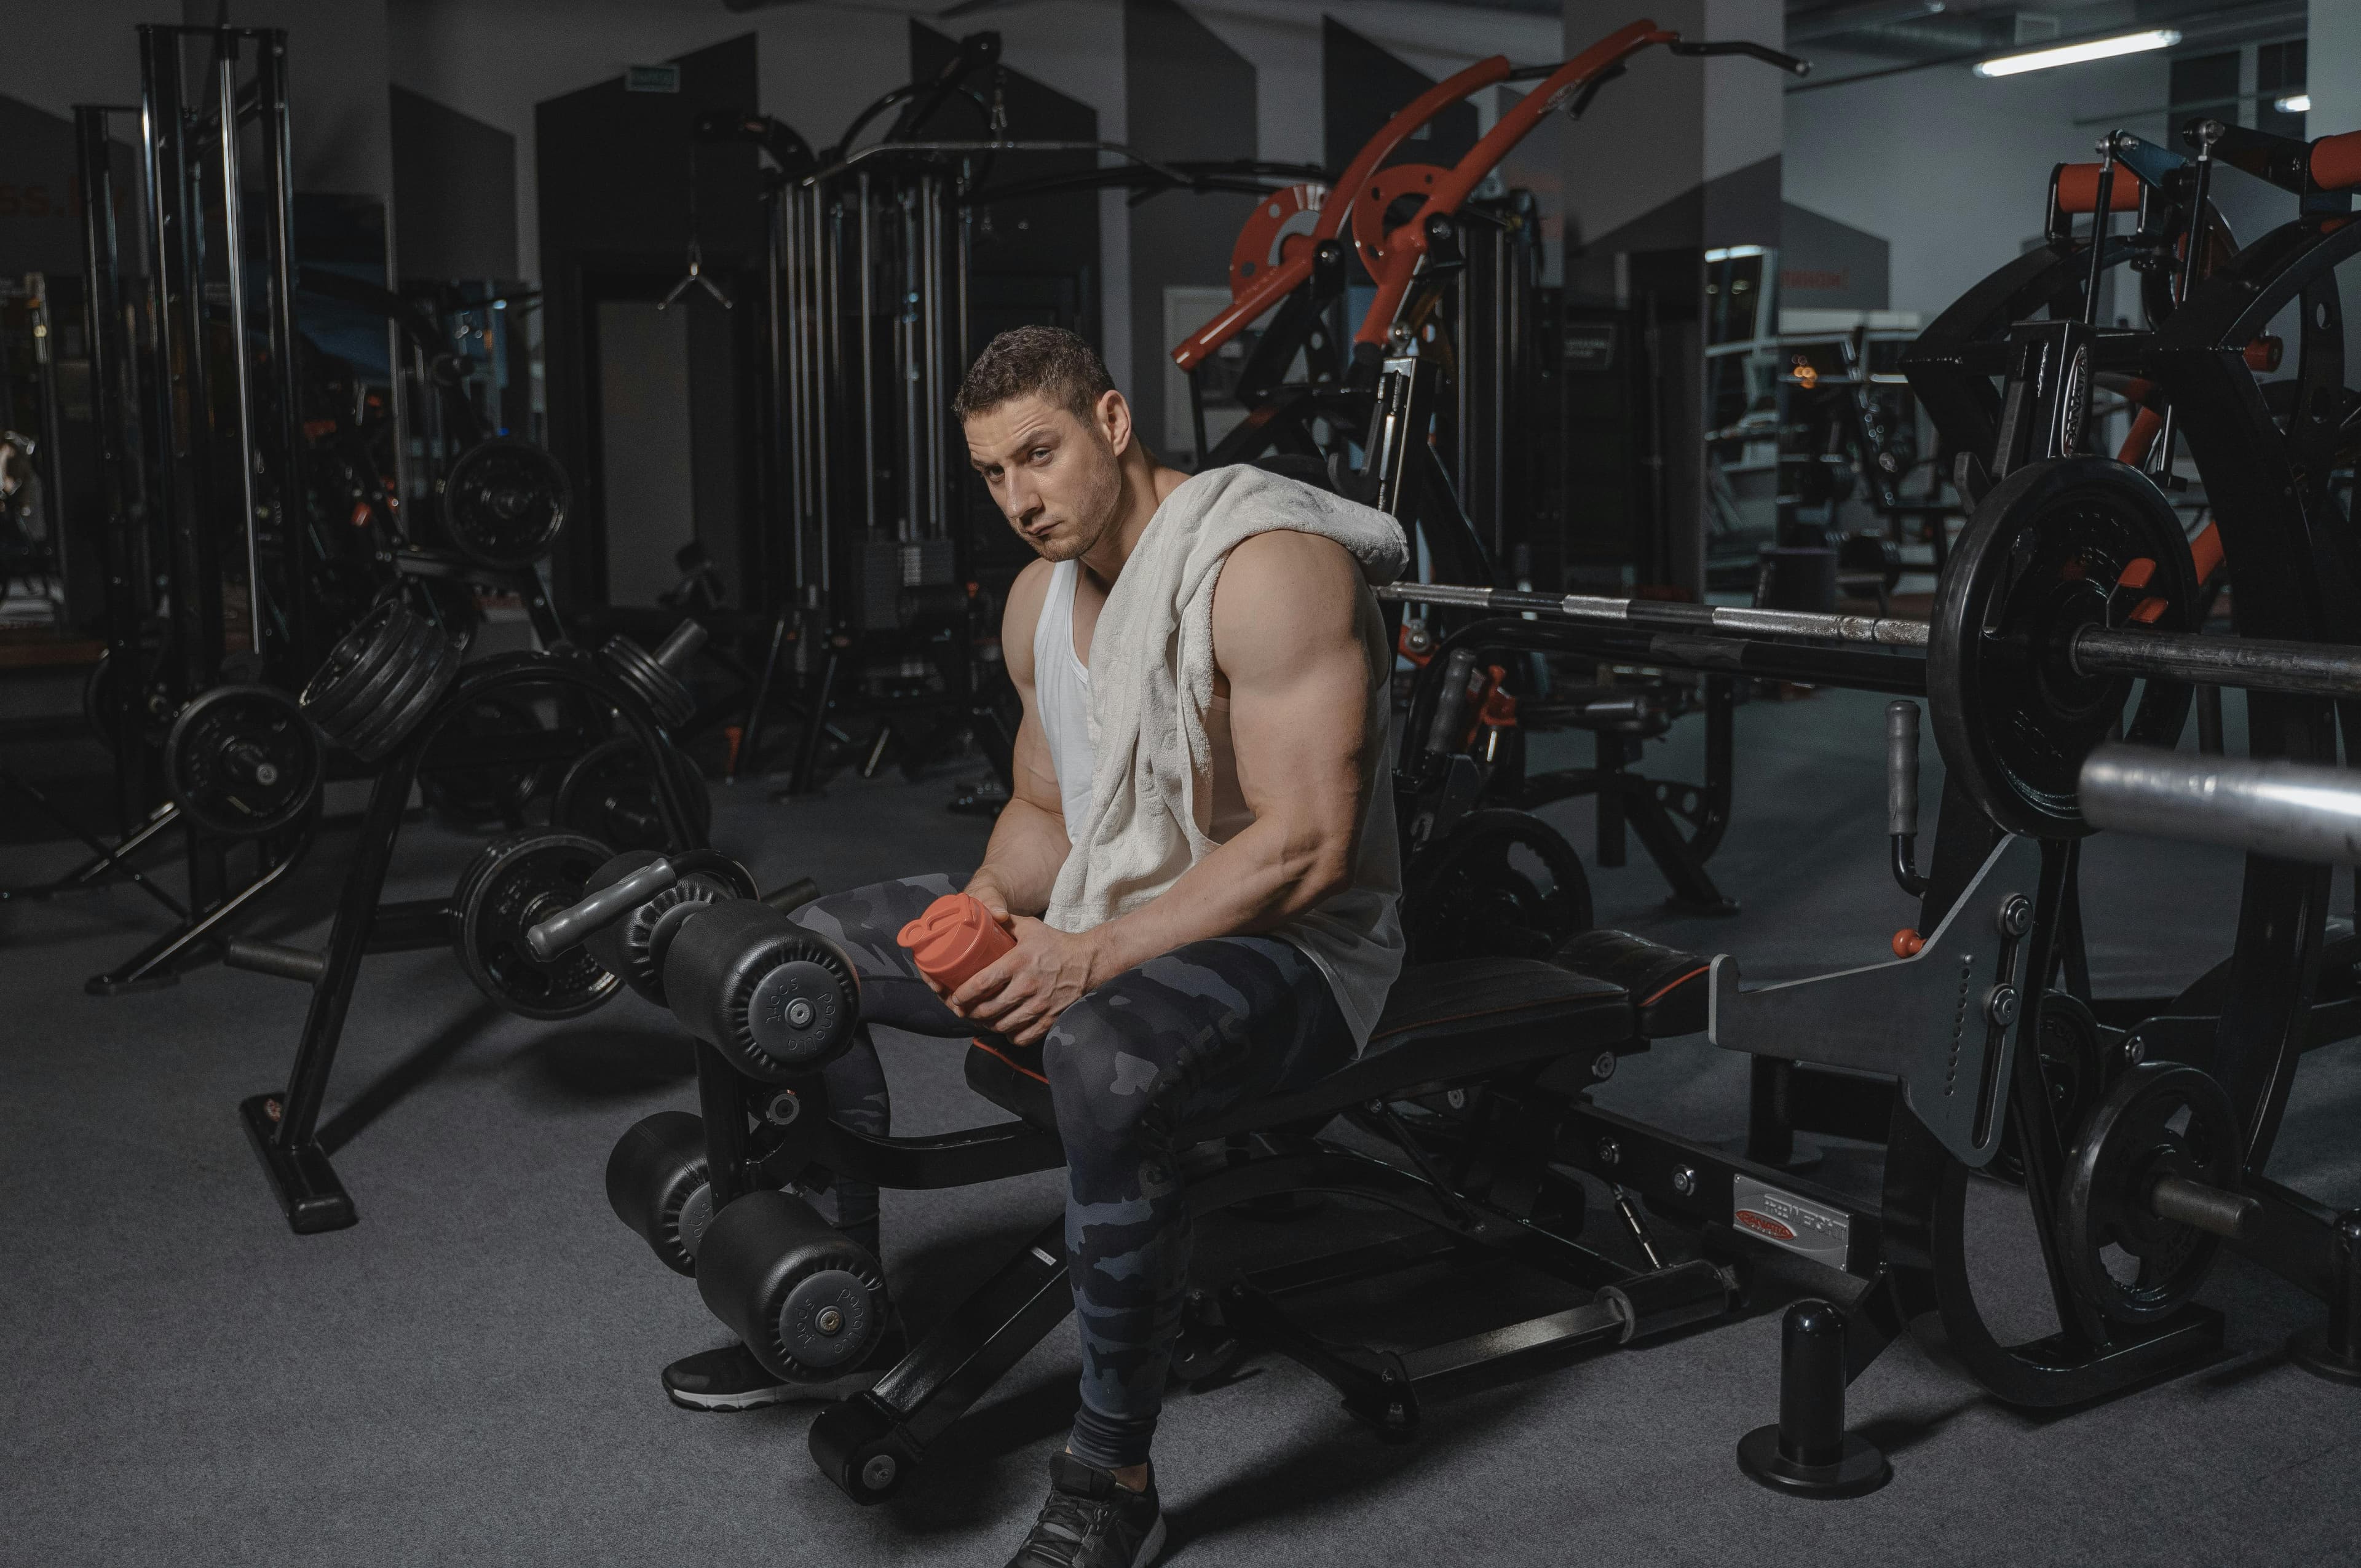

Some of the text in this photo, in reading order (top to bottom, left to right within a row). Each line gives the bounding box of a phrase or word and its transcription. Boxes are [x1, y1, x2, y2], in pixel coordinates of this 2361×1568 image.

[788, 991, 836, 1055] panatta
[687, 1202, 712, 1245] atta
[794, 1298, 816, 1349] sport
[834, 1288, 864, 1353] panatta
